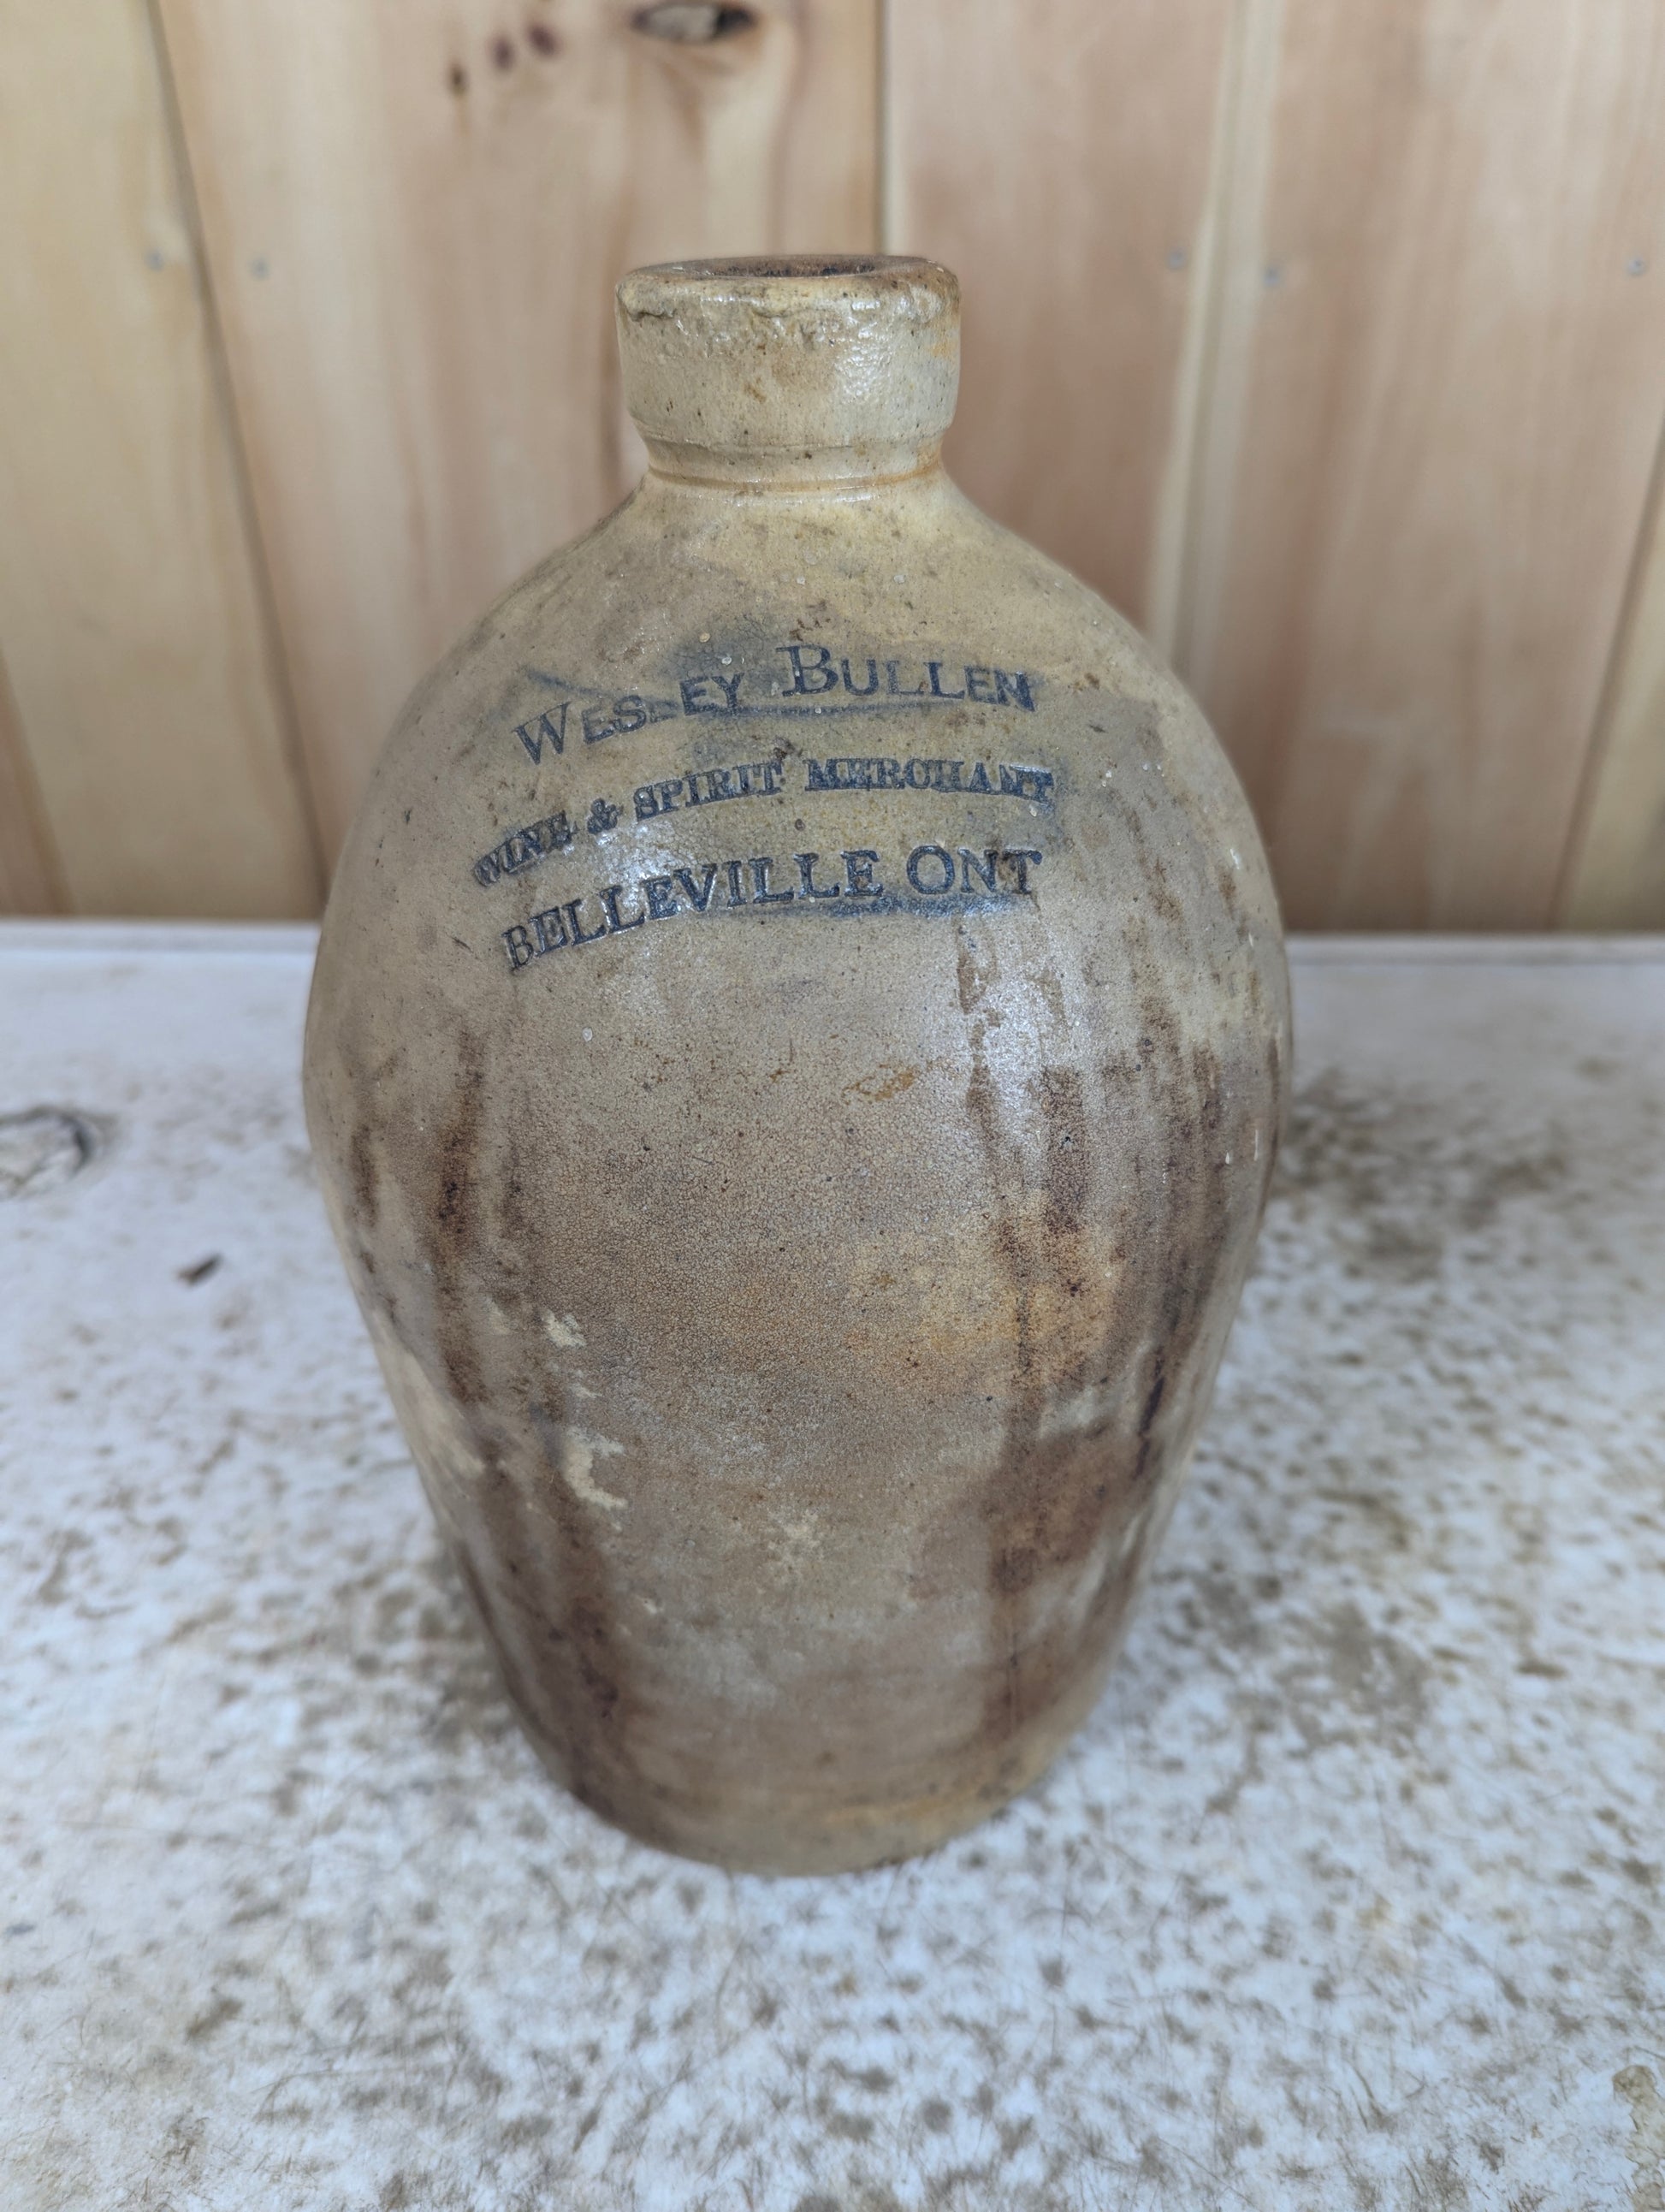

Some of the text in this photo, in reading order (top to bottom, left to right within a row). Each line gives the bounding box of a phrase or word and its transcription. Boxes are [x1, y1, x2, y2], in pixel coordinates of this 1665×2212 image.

[776, 644, 1036, 712] BULLEN
[587, 798, 623, 835] &
[803, 756, 1055, 809] MERCHANT
[501, 845, 1043, 971] BELLEVILLE ONT
